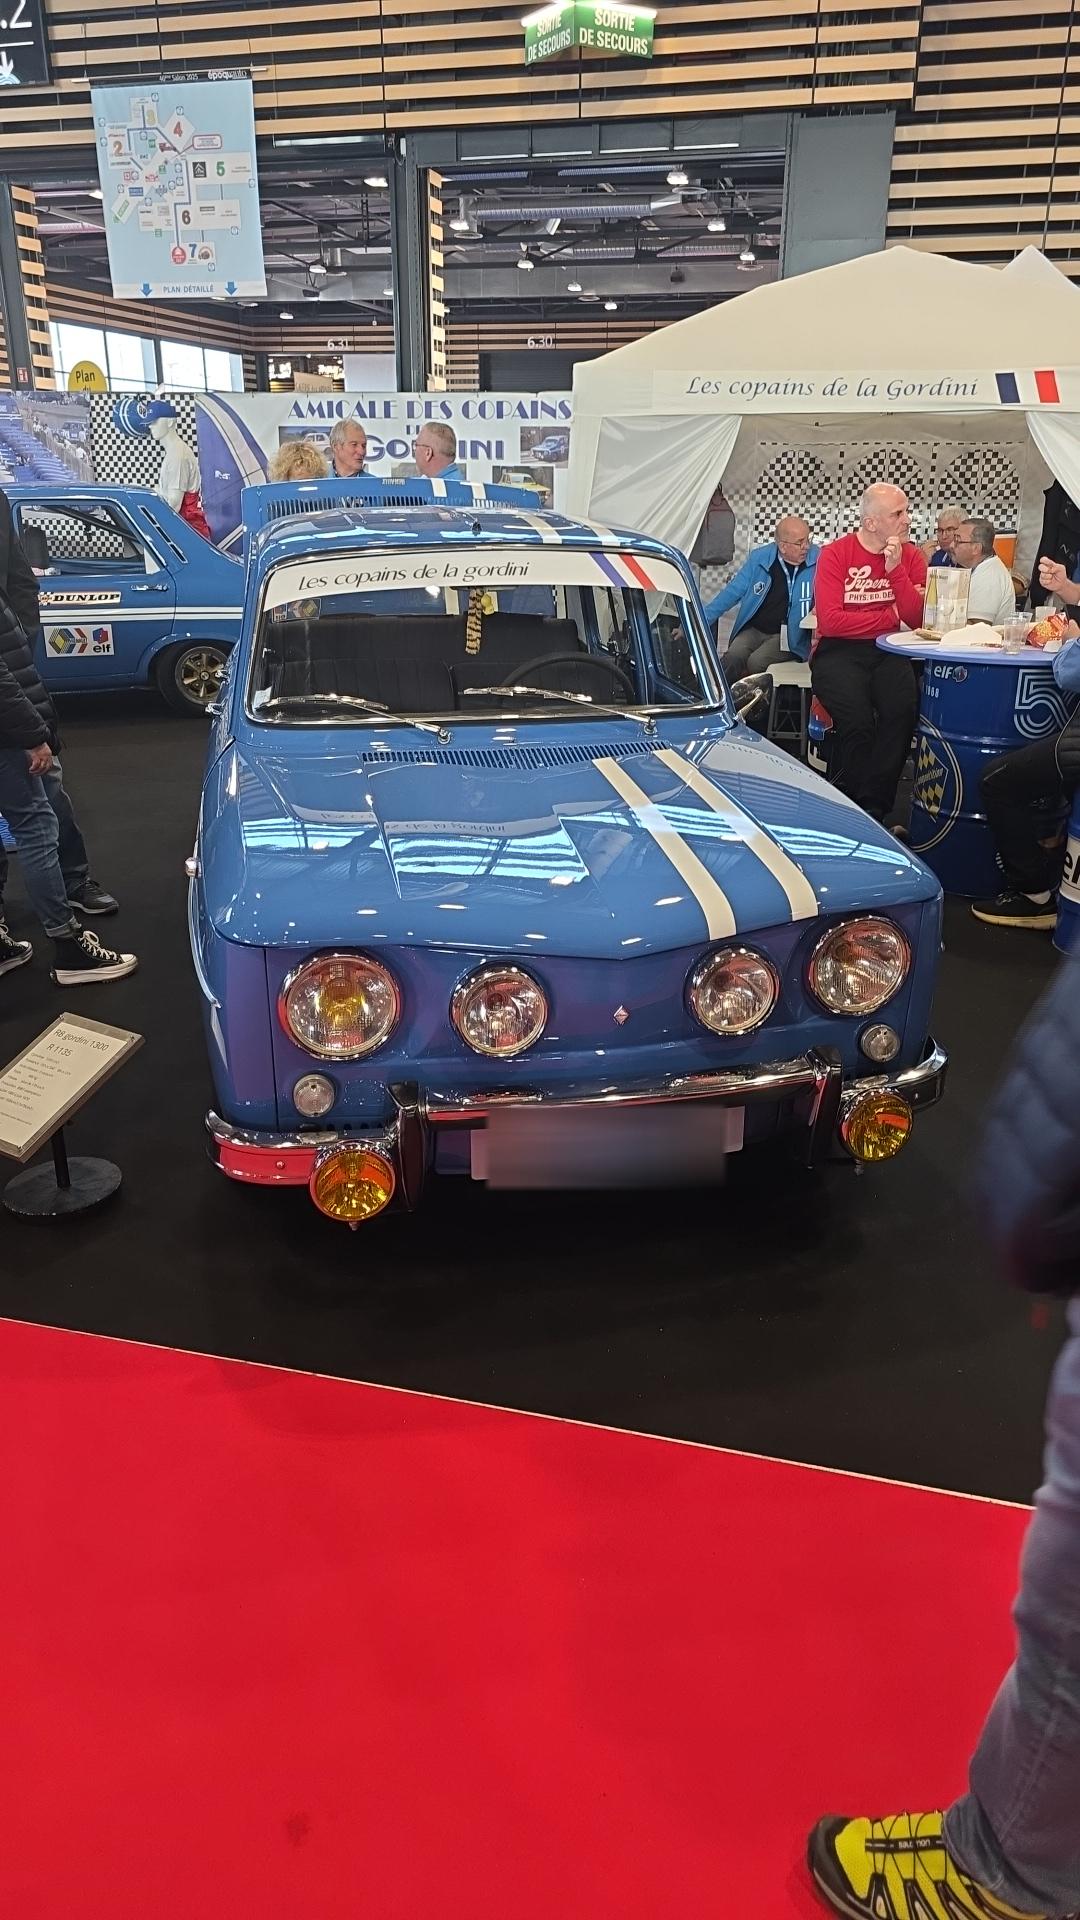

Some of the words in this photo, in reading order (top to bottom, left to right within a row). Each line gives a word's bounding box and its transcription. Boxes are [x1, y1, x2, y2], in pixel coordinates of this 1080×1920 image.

[594, 7, 636, 32] SORTIE
[527, 45, 537, 62] DE
[538, 28, 571, 58] SECOURS
[579, 27, 595, 46] DE
[596, 30, 649, 56] SECOURS
[173, 121, 184, 138] 4
[112, 140, 124, 156] 2
[215, 161, 226, 177] 5
[181, 209, 191, 225] 6
[188, 243, 198, 259] 7
[163, 285, 181, 294] PLAN
[183, 283, 214, 294] DÉTAILLÉ
[327, 338, 350, 350] 6.31
[527, 336, 553, 349] 6.30
[75, 370, 96, 383] Plan
[685, 376, 722, 395] Les
[728, 378, 815, 402] copains
[821, 377, 848, 397] de
[856, 377, 878, 397] la
[886, 376, 979, 401] Gordini
[287, 399, 398, 420] AMICALE
[406, 399, 453, 420] DES
[461, 399, 572, 421] COPAINS
[298, 575, 329, 591] Les
[334, 566, 408, 589] copains
[412, 563, 438, 580] de
[442, 562, 459, 578] la
[462, 561, 530, 583] gordini
[53, 594, 120, 602] DUNLOP
[882, 591, 893, 600] DE
[92, 643, 112, 654] elf
[933, 665, 954, 680] elf
[1062, 851, 1080, 885] el
[53, 1029, 66, 1038] R8
[62, 1033, 90, 1046] gordini
[89, 1040, 110, 1052] 1300
[46, 1043, 55, 1051] R
[54, 1046, 73, 1057] 1135
